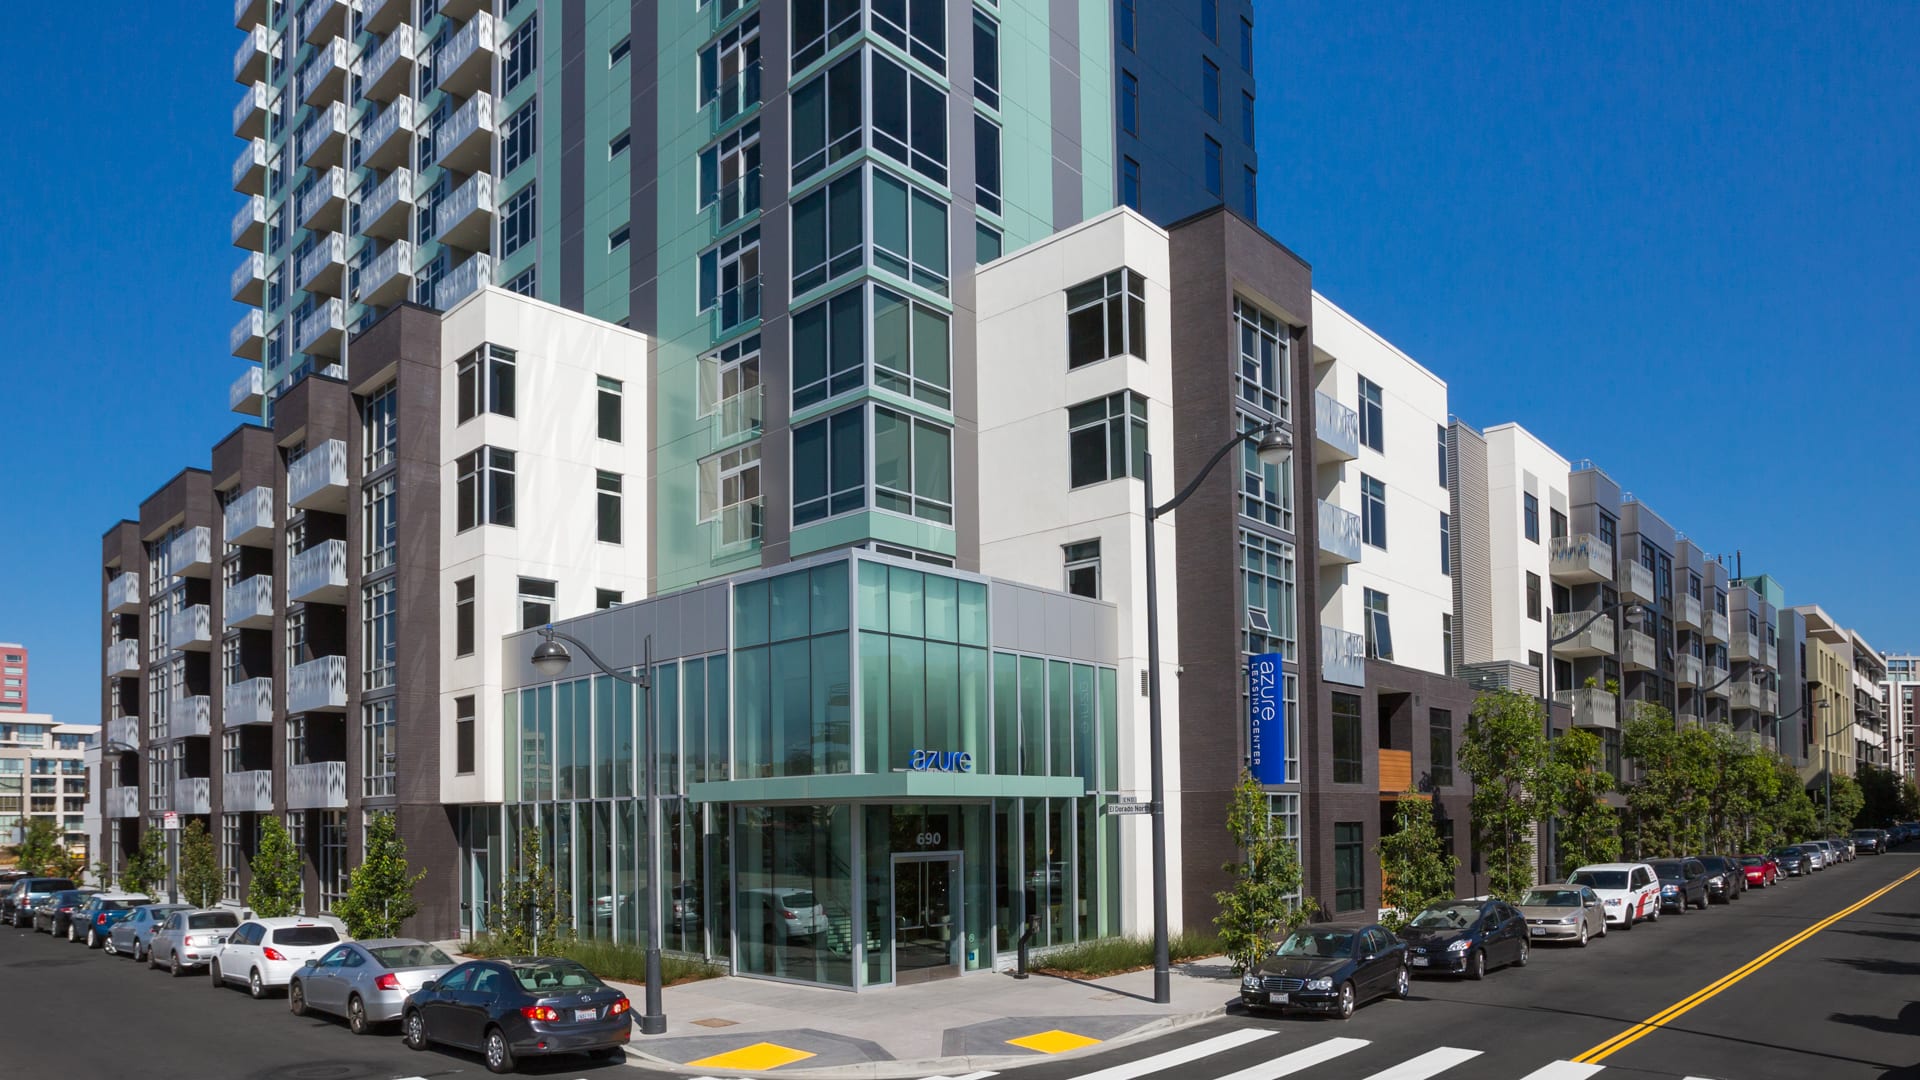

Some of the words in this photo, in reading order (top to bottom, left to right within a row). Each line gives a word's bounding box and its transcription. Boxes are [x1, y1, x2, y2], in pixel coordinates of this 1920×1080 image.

[1251, 663, 1260, 714] LEASING
[1260, 661, 1275, 720] azure
[1252, 719, 1261, 766] CENTER
[910, 749, 972, 772] azure
[1109, 805, 1114, 813] El
[916, 832, 941, 845] 690
